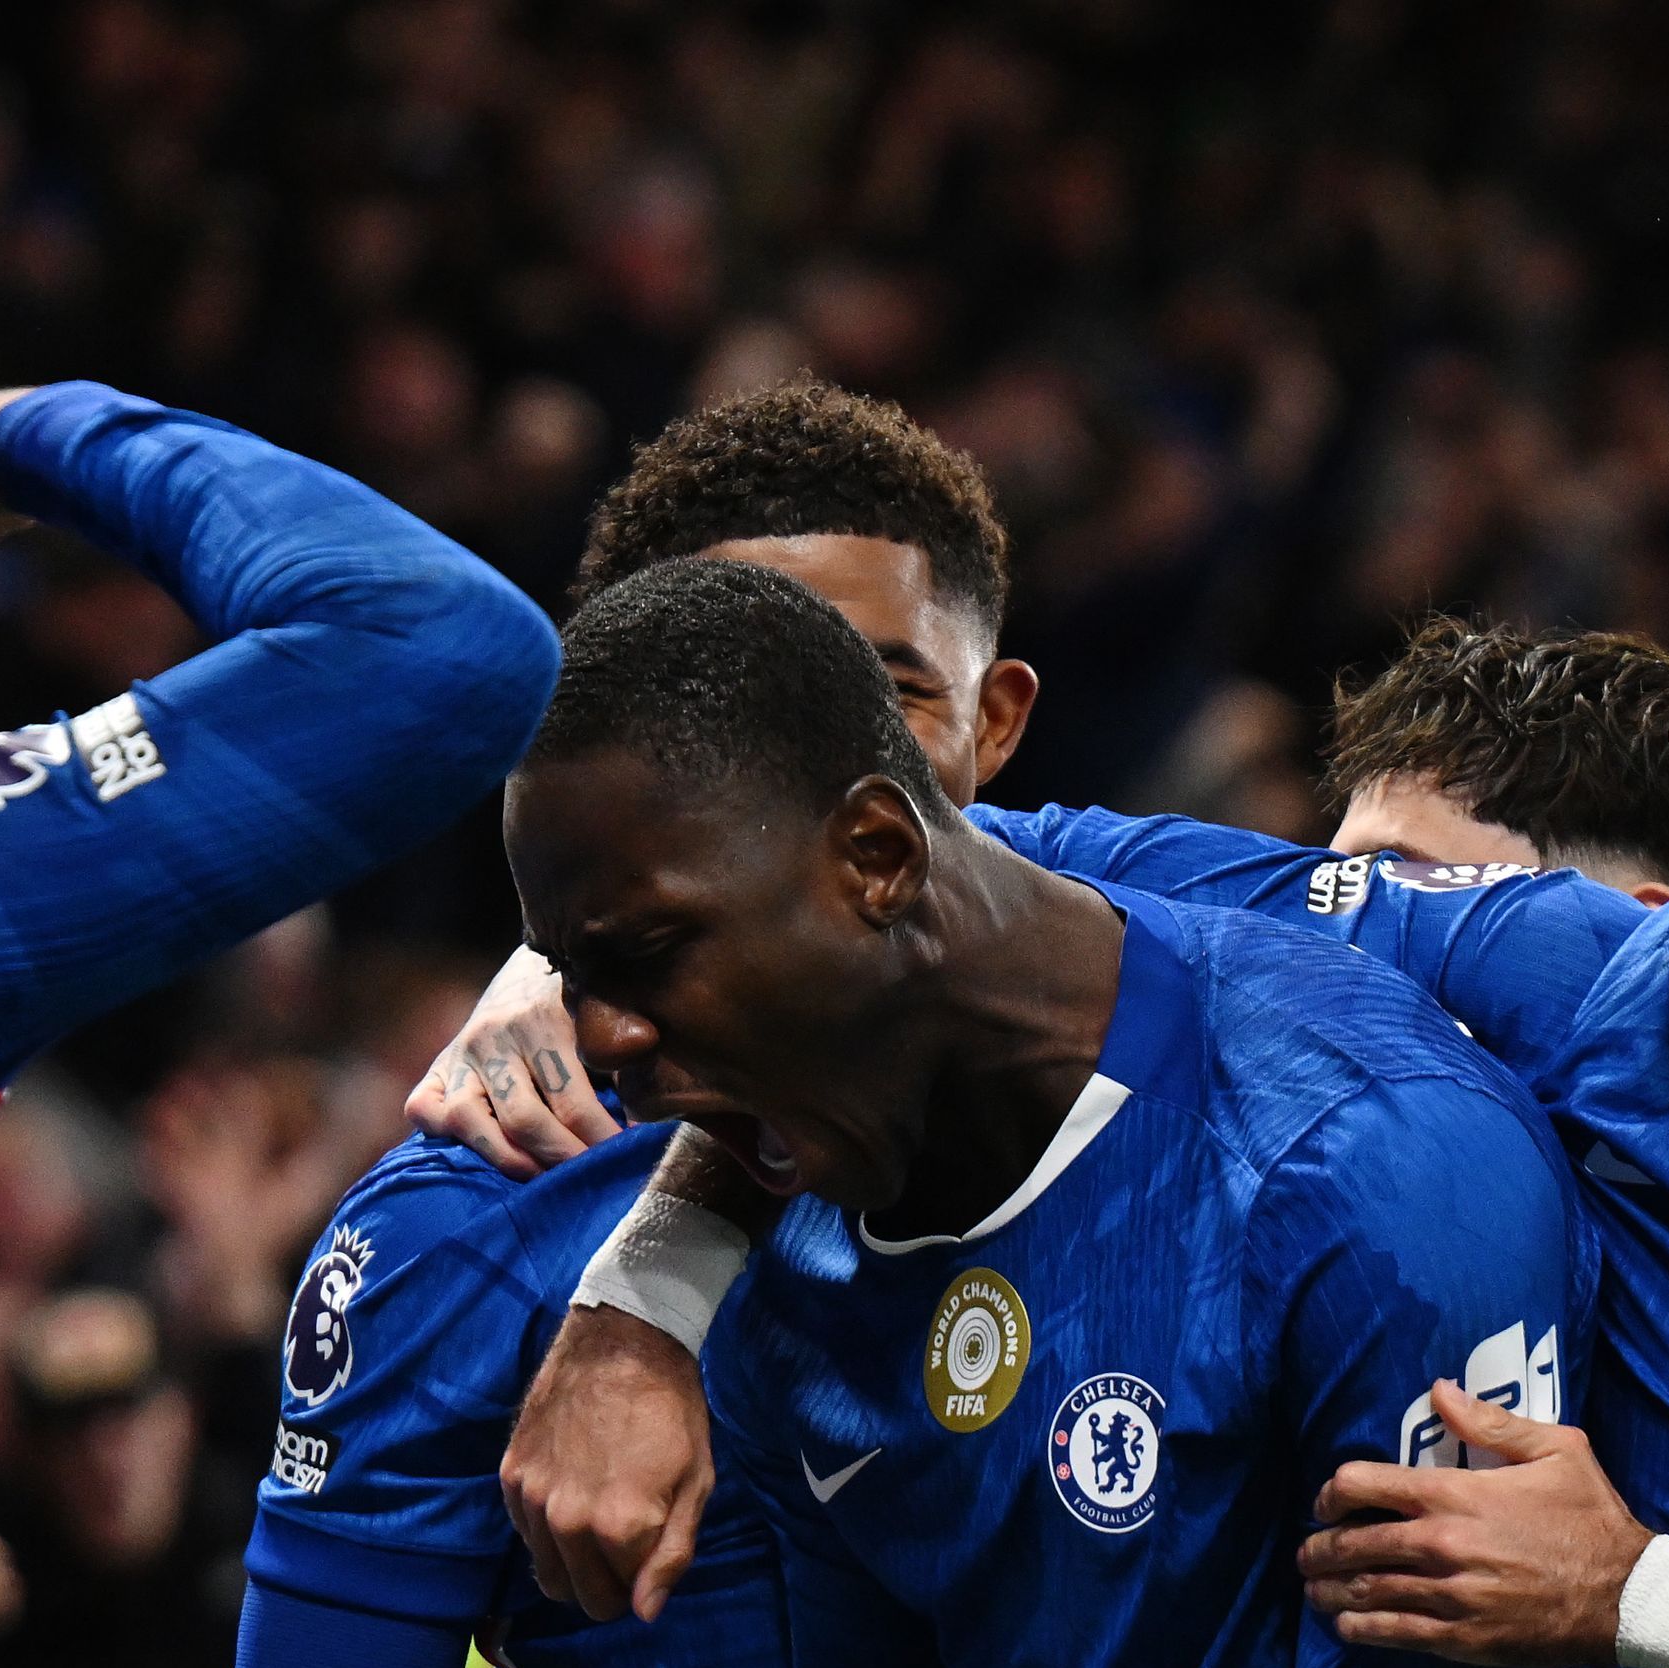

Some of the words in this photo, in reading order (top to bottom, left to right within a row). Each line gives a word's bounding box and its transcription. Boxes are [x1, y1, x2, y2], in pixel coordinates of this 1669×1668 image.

[931, 1295, 960, 1370] WORLD
[962, 1281, 1019, 1368] CHAMPIONS
[945, 1394, 988, 1417] FIFA
[1070, 1378, 1152, 1413] CHELSEA
[1074, 1496, 1128, 1524] FOOTBALL
[1132, 1492, 1157, 1518] CLUB
